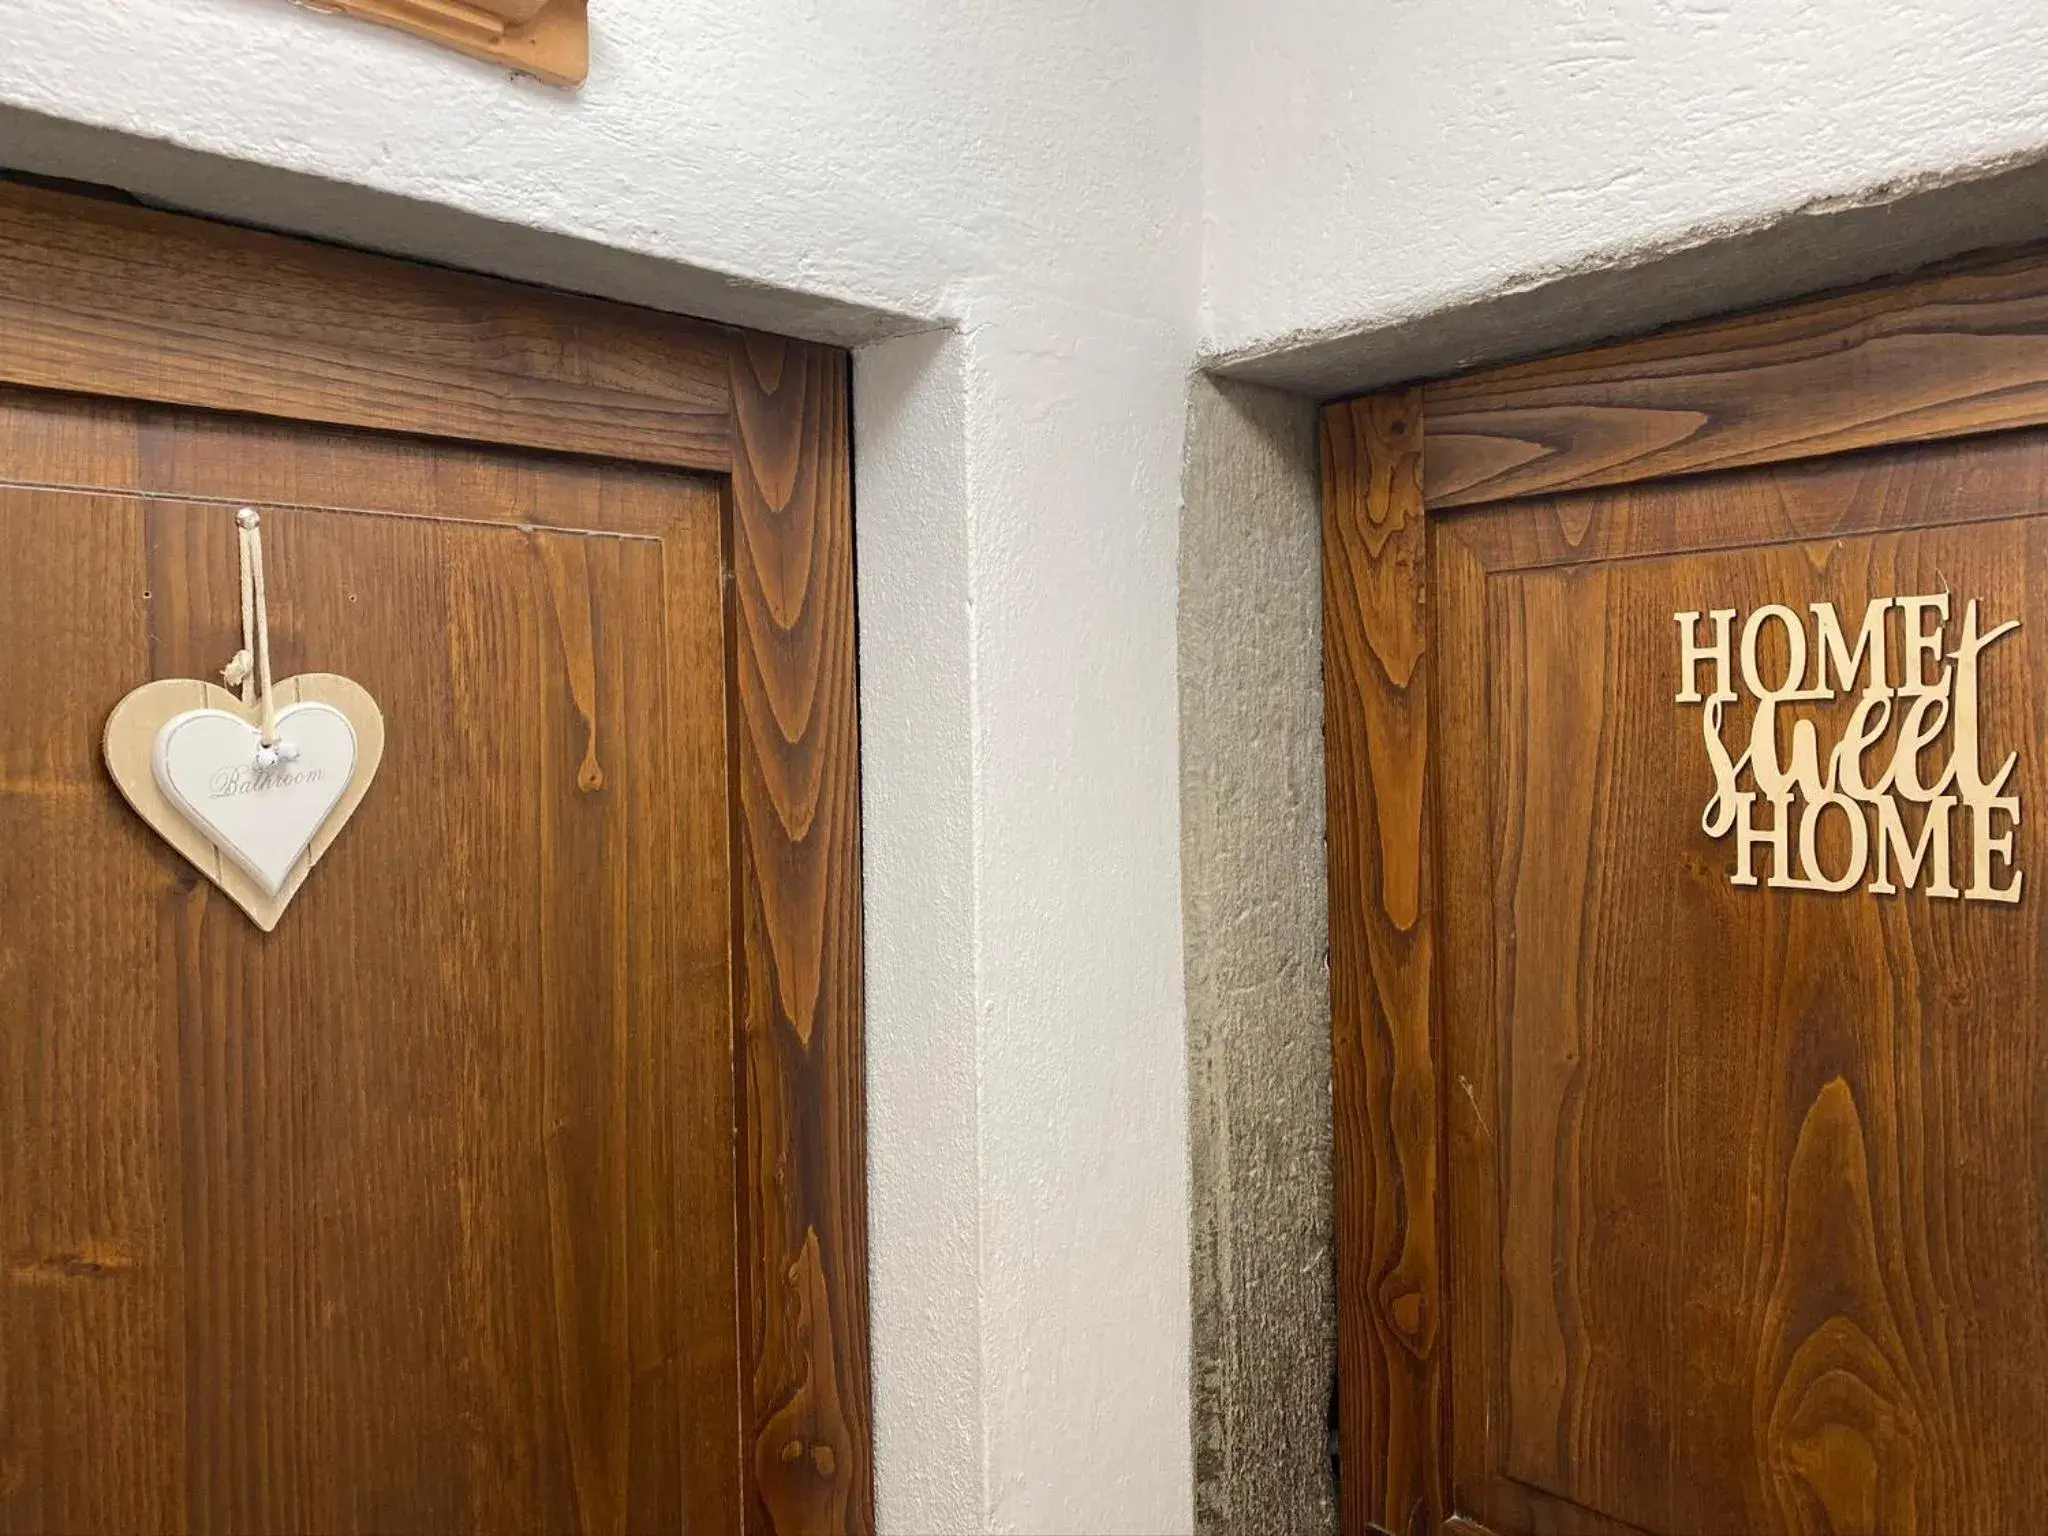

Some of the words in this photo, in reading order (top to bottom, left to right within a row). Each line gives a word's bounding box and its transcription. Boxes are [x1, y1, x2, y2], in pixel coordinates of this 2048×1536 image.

[1674, 593, 1952, 702] HOME
[1702, 598, 2021, 838] sweet
[208, 764, 326, 799] Bathroom
[1730, 792, 2023, 904] HOME
